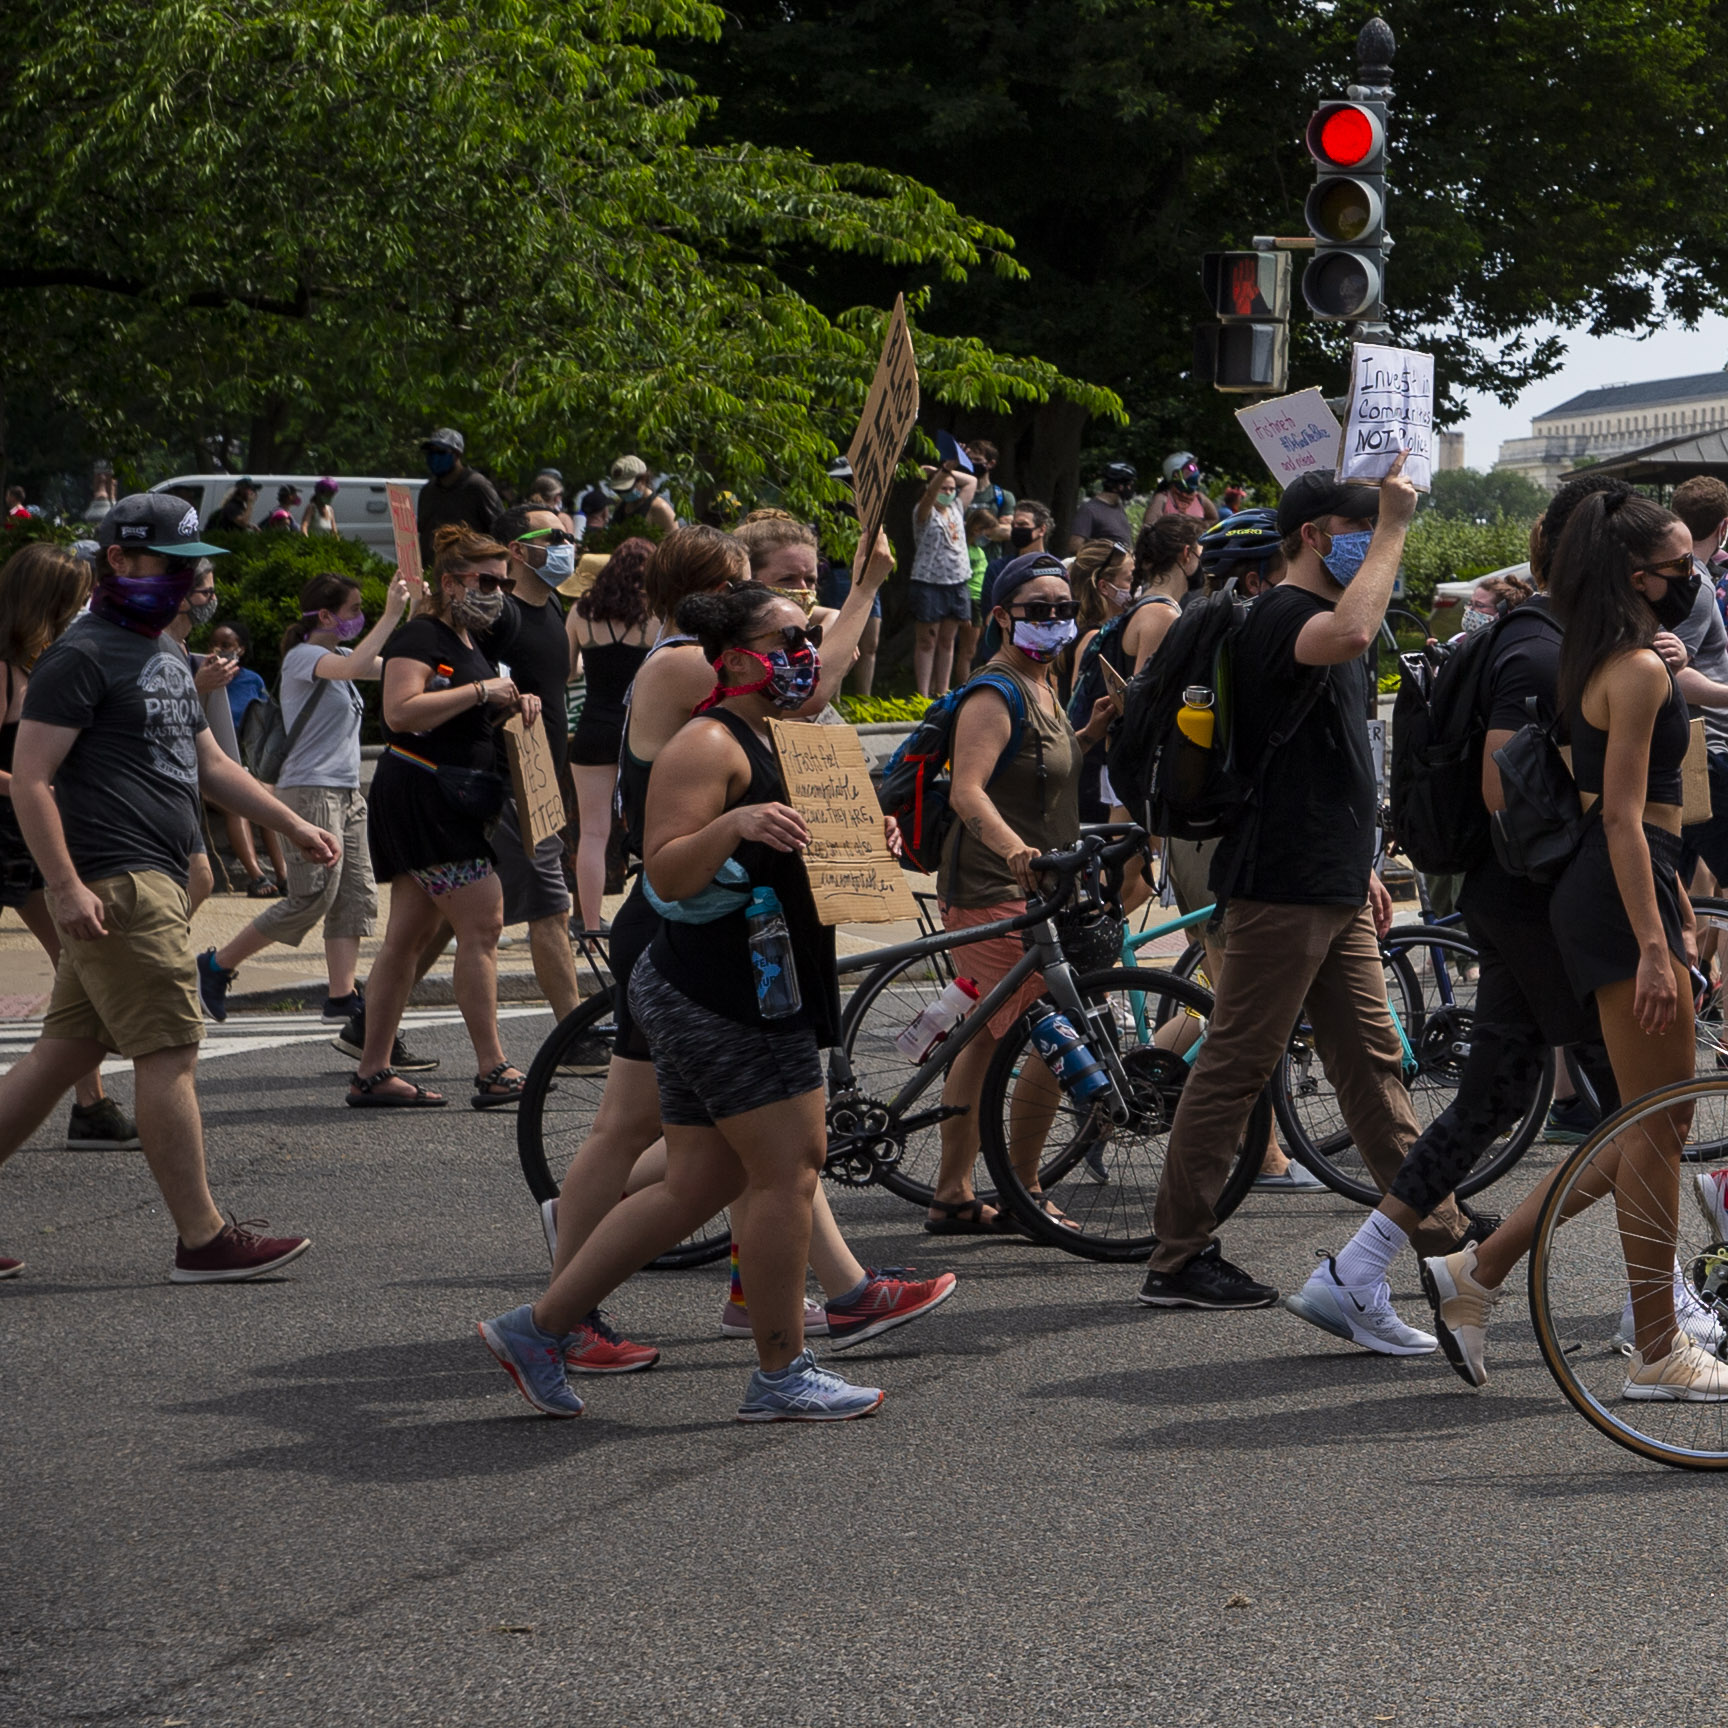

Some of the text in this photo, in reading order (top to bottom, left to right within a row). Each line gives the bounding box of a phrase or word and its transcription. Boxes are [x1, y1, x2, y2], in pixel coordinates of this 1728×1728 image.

[1360, 357, 1431, 394] Invest in
[1354, 429, 1395, 453] NOT
[529, 794, 567, 841] TTER
[826, 806, 850, 829] THEY
